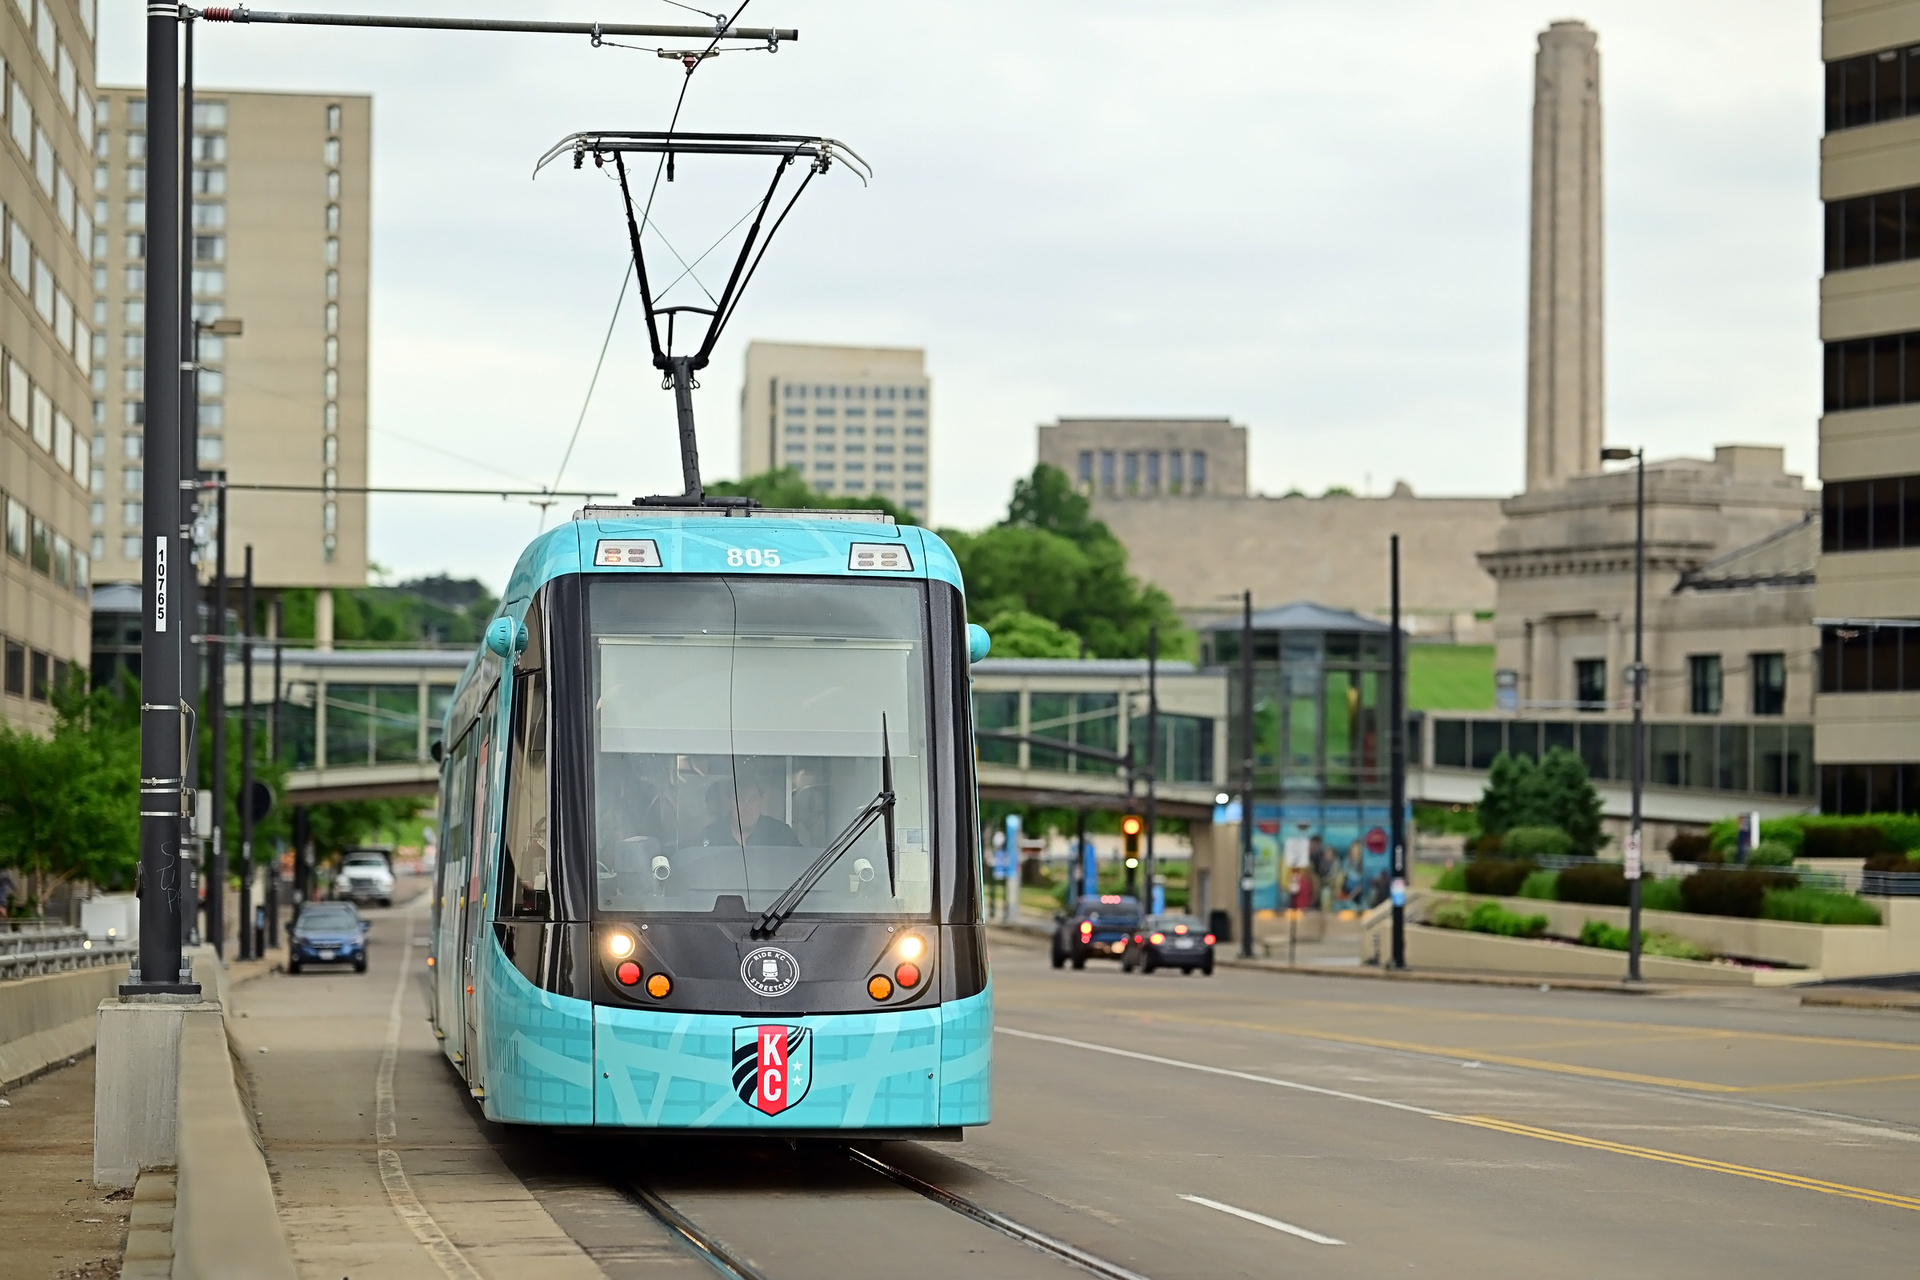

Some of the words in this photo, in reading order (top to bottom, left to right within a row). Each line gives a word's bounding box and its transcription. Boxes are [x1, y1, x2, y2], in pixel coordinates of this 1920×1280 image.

[726, 547, 781, 568] 805
[157, 548, 166, 620] 10765
[753, 951, 772, 961] RIDE
[774, 952, 786, 961] KC
[750, 977, 792, 992] STREETCAR
[763, 1033, 783, 1102] KC
